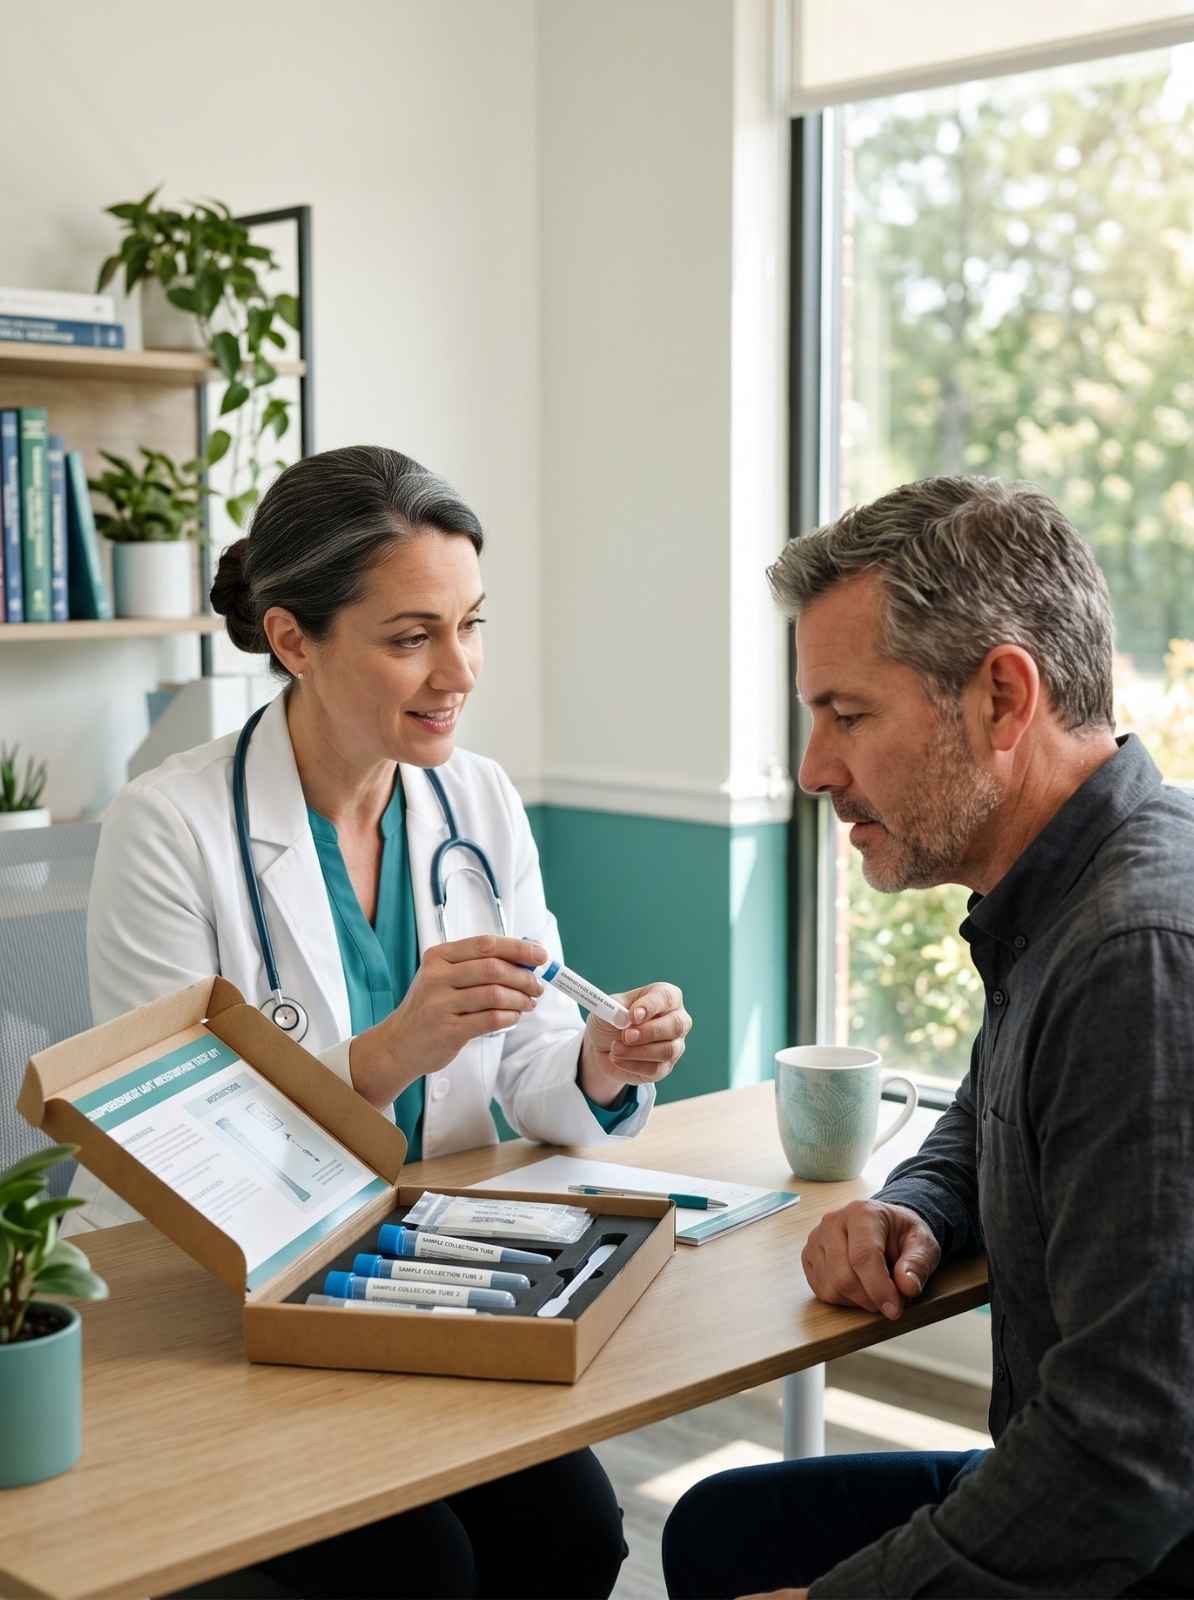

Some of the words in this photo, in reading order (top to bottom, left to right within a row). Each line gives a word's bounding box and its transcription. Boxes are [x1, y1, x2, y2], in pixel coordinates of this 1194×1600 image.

[423, 1237, 443, 1246] SAMPLE
[444, 1241, 479, 1252] COLLECTION
[399, 1266, 422, 1274] SAMPLE
[423, 1269, 460, 1278] COLLECTION
[372, 1283, 396, 1292] SAMPLE
[398, 1286, 437, 1295] COLLECTION
[438, 1289, 454, 1297] TUBE
